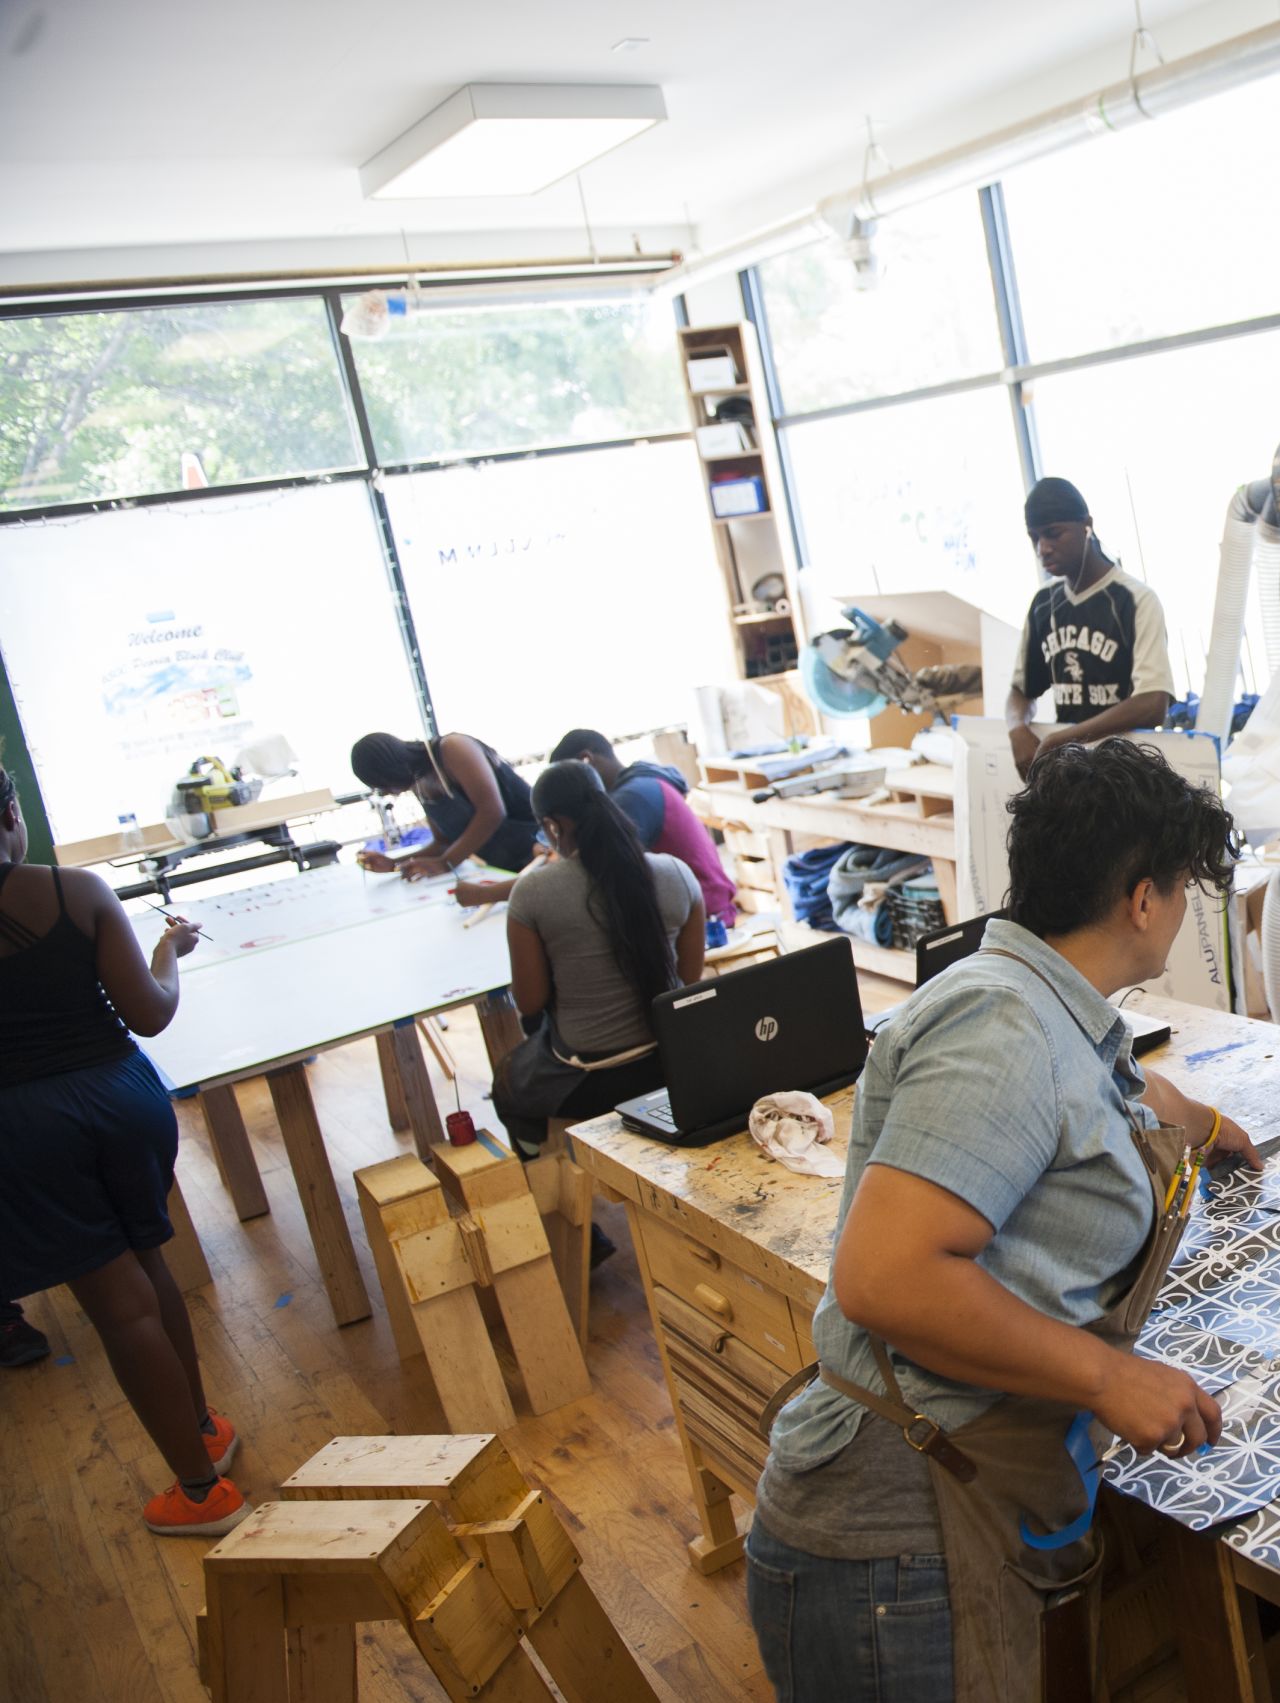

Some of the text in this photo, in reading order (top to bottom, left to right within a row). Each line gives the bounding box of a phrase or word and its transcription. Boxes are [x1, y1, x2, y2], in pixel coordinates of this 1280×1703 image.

[128, 625, 204, 647] Welcome
[1041, 624, 1119, 664] CHICAGO
[1088, 683, 1121, 706] SOX
[759, 1017, 775, 1041] hp
